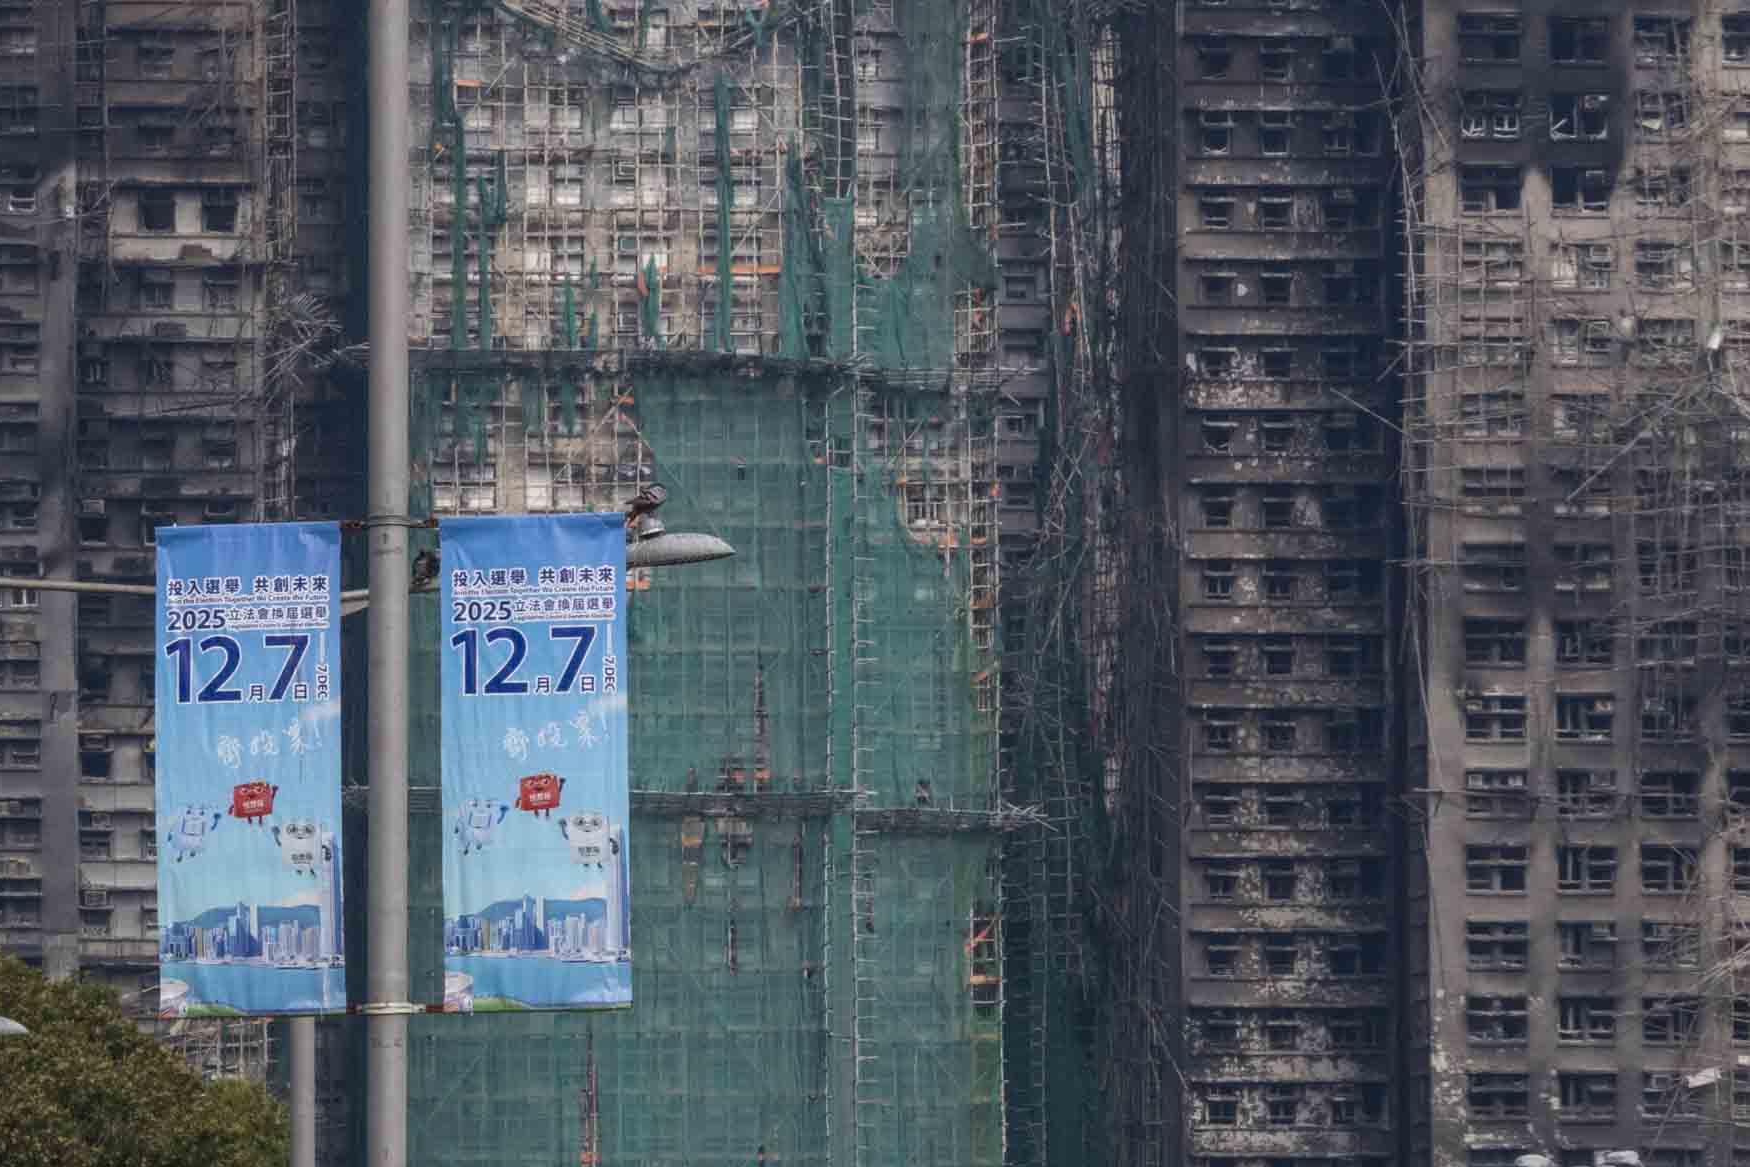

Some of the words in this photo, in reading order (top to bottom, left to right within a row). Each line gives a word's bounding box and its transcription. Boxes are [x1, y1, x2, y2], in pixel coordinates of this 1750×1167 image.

[168, 578, 241, 596] 投入選舉
[254, 577, 328, 593] 共創未來
[453, 570, 526, 586] 投入選舉
[540, 568, 614, 584] 共創未來
[168, 609, 226, 631] 2025
[453, 601, 512, 622] 2025
